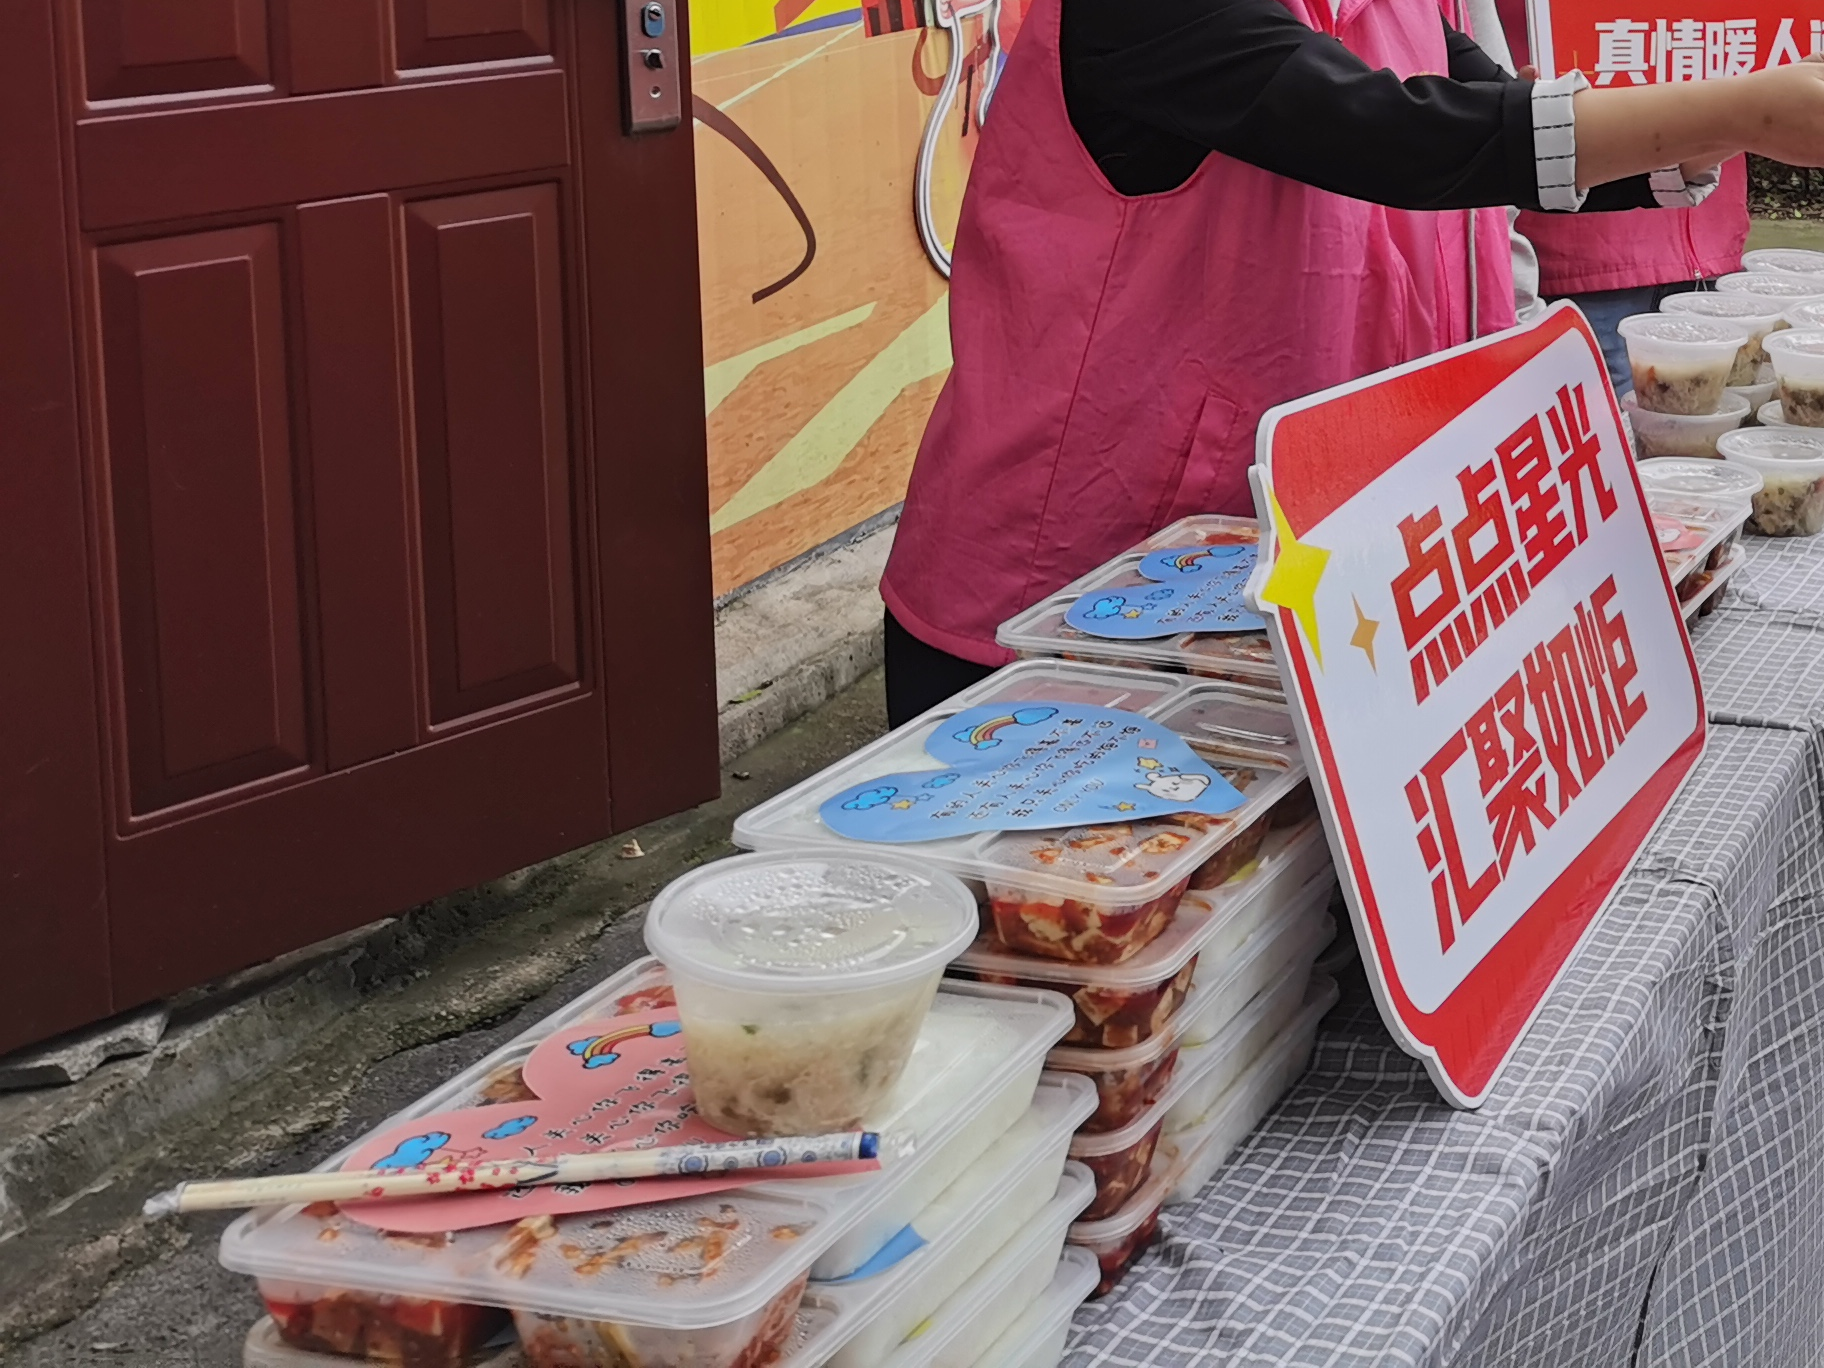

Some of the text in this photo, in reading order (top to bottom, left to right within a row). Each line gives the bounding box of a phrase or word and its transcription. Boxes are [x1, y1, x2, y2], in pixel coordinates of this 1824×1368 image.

[1390, 382, 1619, 706] 点点星光
[1404, 573, 1649, 956] 汇聚如炬
